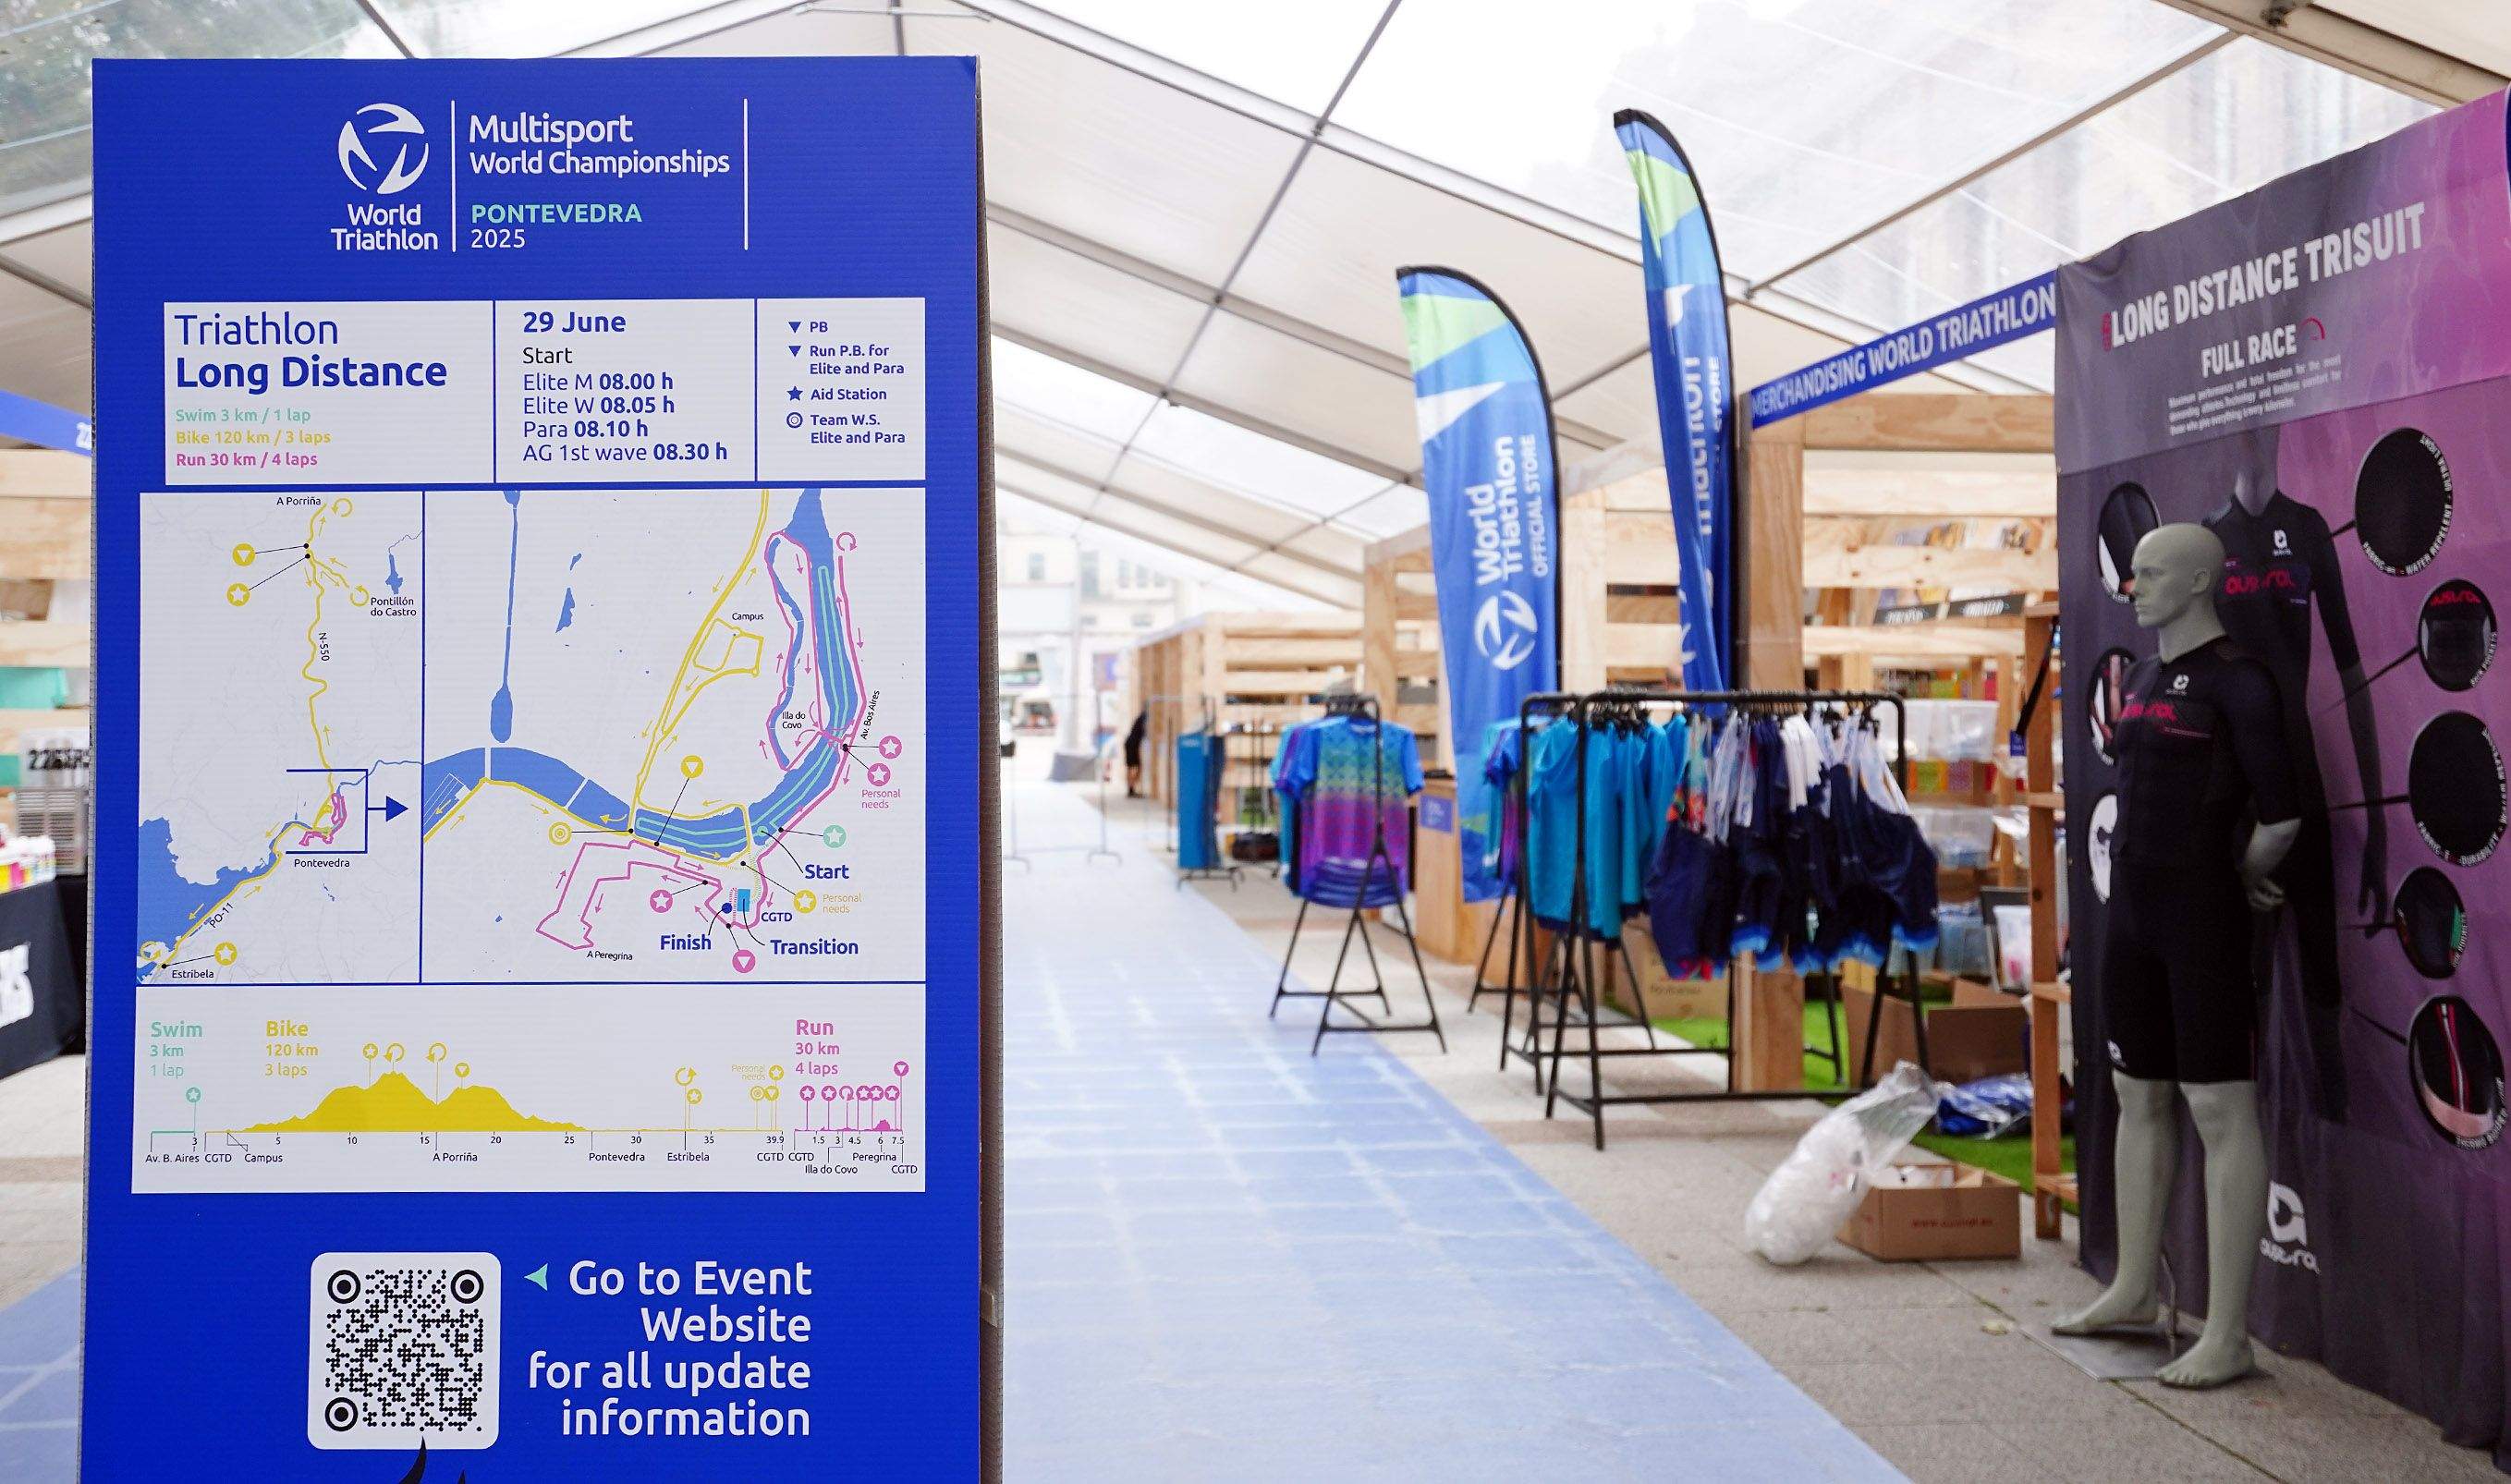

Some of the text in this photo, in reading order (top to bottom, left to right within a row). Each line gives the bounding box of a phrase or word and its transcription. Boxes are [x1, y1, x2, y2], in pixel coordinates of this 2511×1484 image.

[469, 112, 633, 147] Multisport
[470, 148, 729, 177] World Championships
[347, 204, 421, 225] World
[471, 203, 642, 224] PONTEVEDRA
[331, 228, 438, 250] Triathlon
[471, 229, 525, 248] 2025
[2111, 201, 2426, 348] LONG DISTANCE TRISUIT
[175, 311, 337, 345] Triathlon
[524, 311, 626, 333] 29 June
[810, 321, 829, 333] PB
[523, 347, 572, 363] Start
[810, 344, 890, 357] Run P.B. for
[1753, 282, 2056, 418] MERCHANDISING WORLD TRIATHLON
[2200, 323, 2298, 378] FULL RACE
[177, 354, 446, 395] Long Distance
[810, 361, 905, 375] Elite and Para
[525, 372, 673, 390] Elite M 08.00 h
[811, 387, 887, 401] Aid Station
[525, 395, 674, 414] Elite W 08.05 h
[177, 408, 216, 421] Swim
[222, 408, 229, 421] 3
[234, 407, 258, 421] km
[273, 408, 282, 421] 1
[286, 407, 311, 424] lap
[810, 414, 881, 426] Team W.S.
[525, 419, 648, 437] Para 08.10 h
[177, 429, 210, 444] Bike
[213, 431, 242, 444] 120
[246, 429, 269, 443] km
[286, 429, 295, 444] 3
[299, 429, 331, 445] laps
[811, 431, 906, 444] Elite and Para
[523, 442, 726, 461] AG 1st wave 08.30 h
[177, 453, 206, 467] Run
[210, 453, 229, 467] 30
[234, 453, 256, 466] km
[271, 453, 282, 466] 4
[286, 452, 317, 468] laps
[276, 496, 322, 505] A Porriña
[1518, 433, 1548, 578] OFFICIAL STORE
[1494, 436, 1524, 582] Triathlon
[1464, 483, 1502, 586] World
[371, 596, 414, 606] Pontillón
[370, 607, 417, 616] do Castro
[731, 612, 764, 622] Campus
[318, 632, 330, 662] N-550
[782, 711, 806, 720] Illa do
[860, 689, 880, 740] Av. Bos Aires
[782, 721, 802, 729] Covo
[862, 789, 900, 800] Personal
[861, 800, 889, 809] needs
[294, 858, 350, 868] Pontevedra
[805, 864, 849, 879] Start
[823, 893, 861, 902] Personal
[210, 902, 234, 929] PO-11
[823, 904, 850, 914] needs
[761, 911, 793, 922] CGTD
[660, 935, 712, 951] Finish
[771, 939, 858, 955] Transition
[587, 950, 633, 962] A Peregrina
[172, 968, 214, 979] Estribela
[152, 1020, 203, 1039] Swim
[265, 1019, 309, 1038] Bike
[797, 1019, 833, 1035] Run
[150, 1043, 185, 1056] 3 km
[265, 1042, 319, 1056] 120 km
[795, 1041, 839, 1055] 30 km
[150, 1064, 185, 1078] 1 lap
[265, 1063, 309, 1078] 3 laps
[795, 1062, 837, 1077] 4 laps
[347, 1137, 358, 1145] 10
[420, 1136, 430, 1145] 15
[490, 1136, 502, 1145] 20
[564, 1136, 575, 1145] 25
[630, 1136, 642, 1144] 30
[703, 1136, 714, 1144] 35
[766, 1136, 785, 1145] 39.9
[812, 1136, 825, 1145] 1.5
[848, 1136, 861, 1145] 4.5
[892, 1137, 905, 1145] 7.5
[145, 1153, 200, 1163] Av. B. Aires
[204, 1153, 232, 1163] CGTD
[244, 1153, 284, 1164] Campus
[433, 1152, 478, 1162] A Porriña
[589, 1151, 645, 1162] Pontevedra
[667, 1151, 710, 1162] Estribela
[756, 1152, 785, 1162] CGTD
[788, 1152, 815, 1162] CGTD
[852, 1152, 896, 1163] Peregrina
[805, 1163, 859, 1174] Illa do Covo
[891, 1164, 918, 1174] CGTD
[570, 1260, 811, 1295] Go to Event
[641, 1304, 811, 1342] Website
[530, 1351, 810, 1398] for all update
[563, 1397, 809, 1436] information
